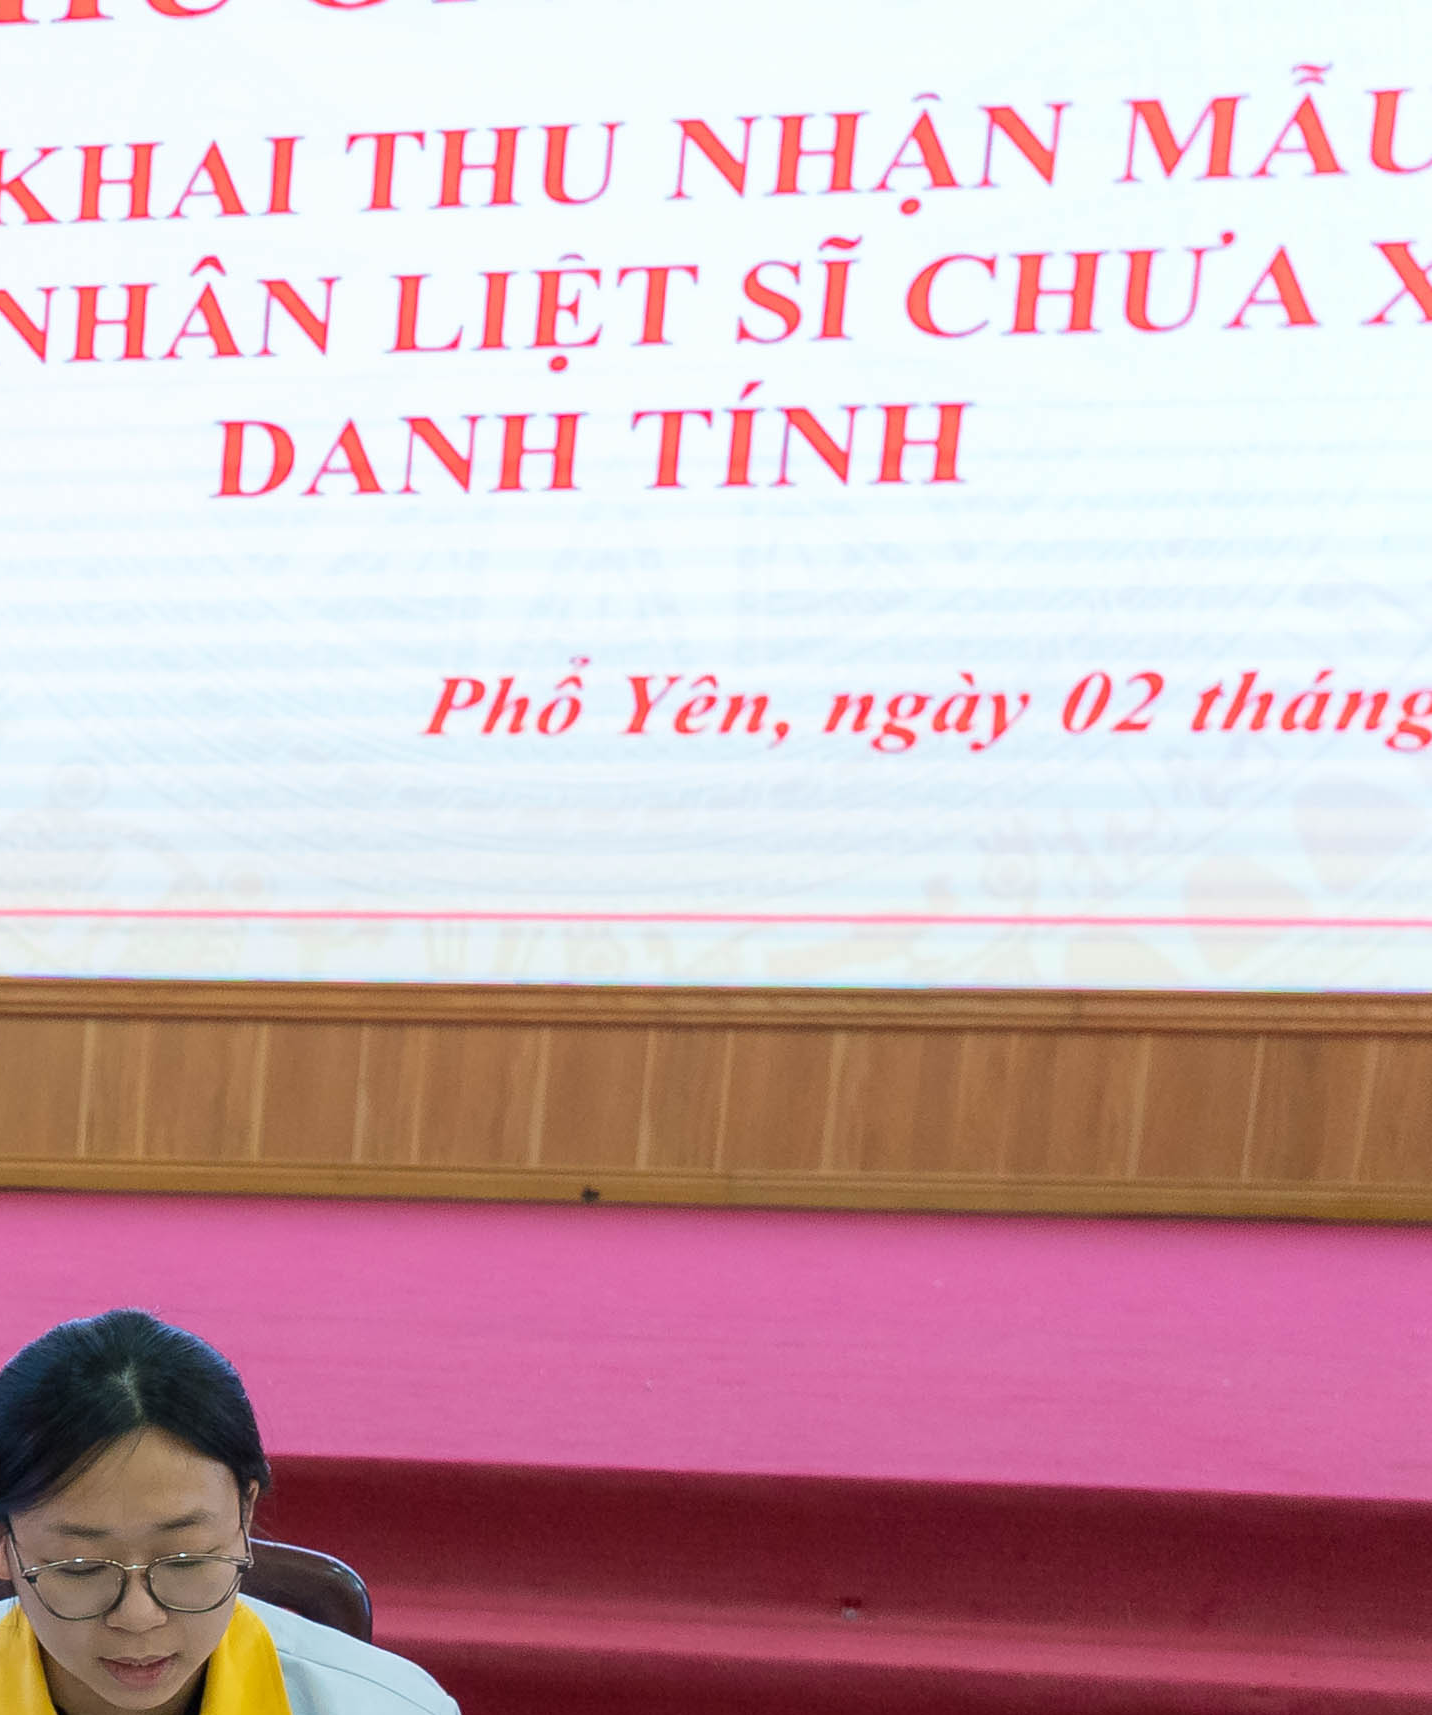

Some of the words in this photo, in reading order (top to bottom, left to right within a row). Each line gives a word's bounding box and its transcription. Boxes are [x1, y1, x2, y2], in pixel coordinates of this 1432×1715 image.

[344, 122, 621, 212] THU
[670, 92, 1071, 218] NHẬN
[1113, 62, 1432, 184] MẪU
[389, 256, 701, 374] LIỆT
[735, 235, 863, 345] SĨ
[903, 230, 1321, 340] CHƯA
[212, 411, 585, 498] DANH
[630, 380, 971, 489] TÍNH
[423, 656, 585, 737] Phổ
[621, 672, 792, 746] Yên,
[821, 670, 1031, 753] ngày
[1061, 671, 1166, 734] 02
[1190, 669, 1432, 754] tháng
